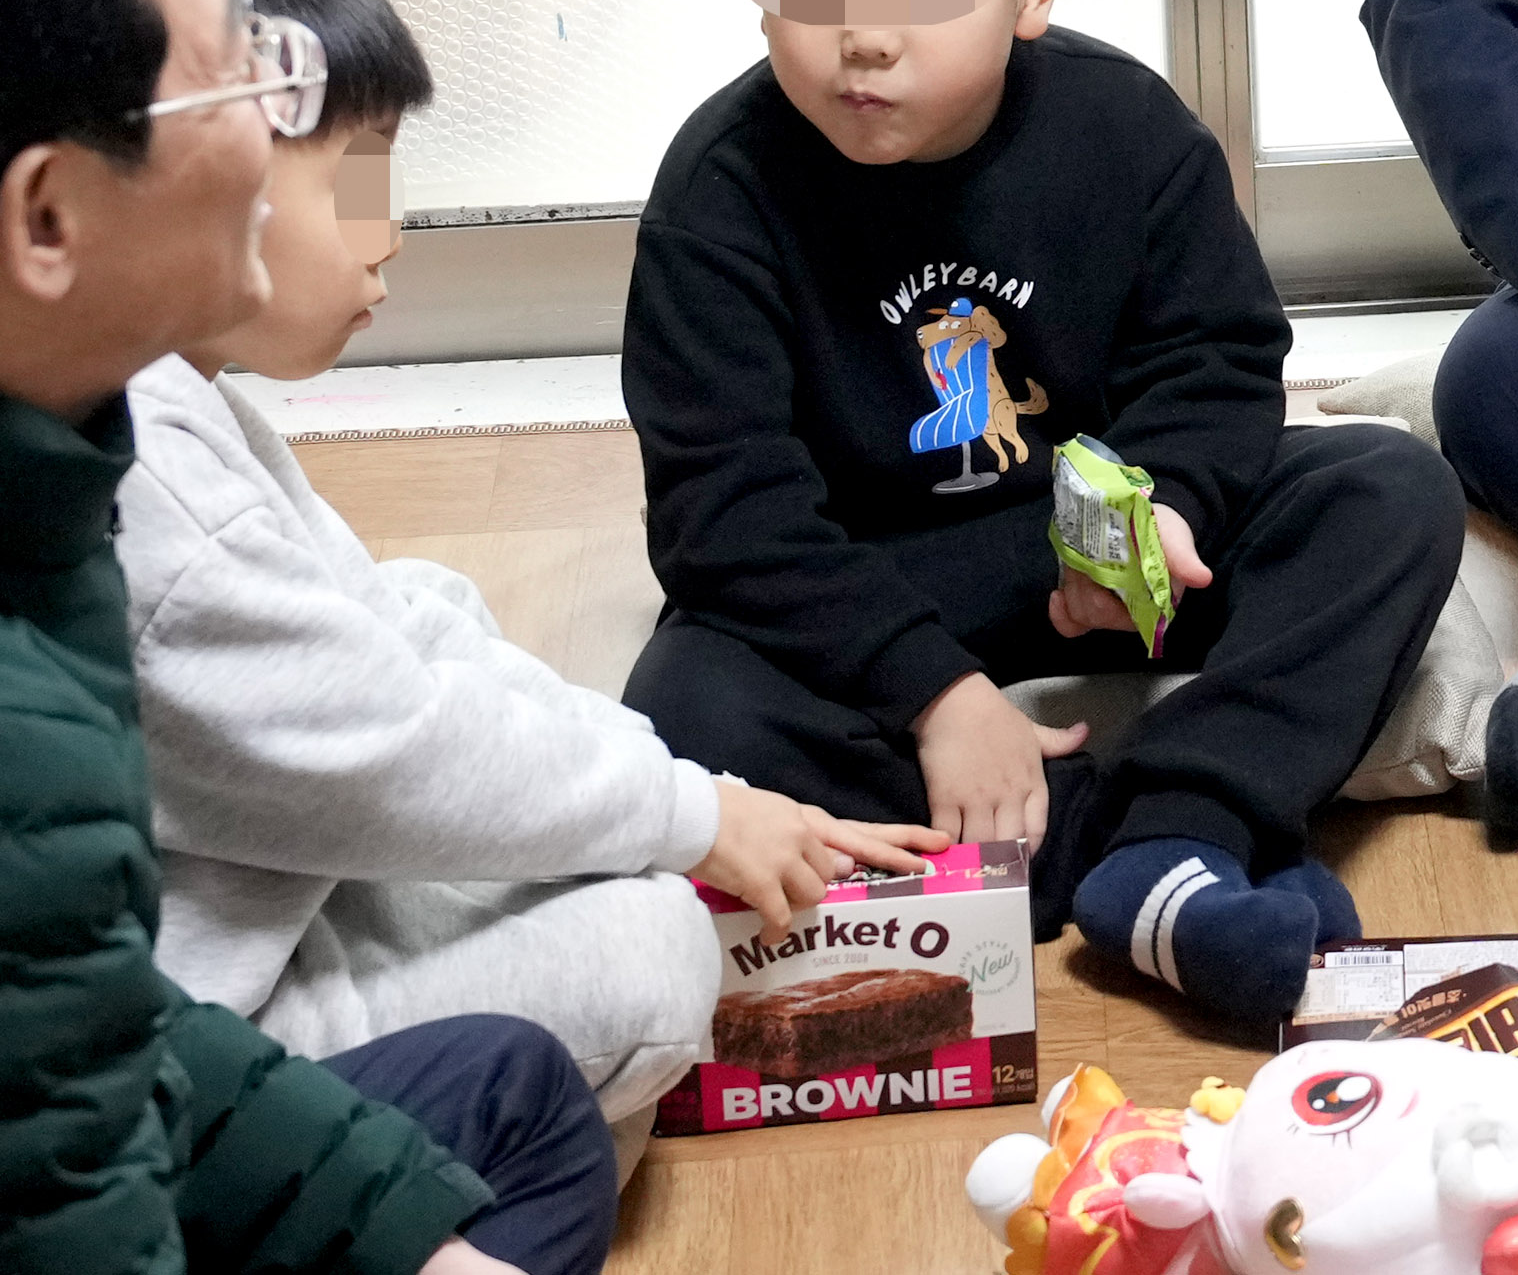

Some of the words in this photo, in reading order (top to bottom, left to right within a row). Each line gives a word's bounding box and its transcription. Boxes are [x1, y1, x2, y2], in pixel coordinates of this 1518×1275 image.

[879, 262, 1035, 325] OWLEYBARN
[729, 915, 901, 976] Market
[910, 921, 949, 959] O
[966, 950, 1014, 993] New
[722, 1065, 973, 1122] BROWNIE
